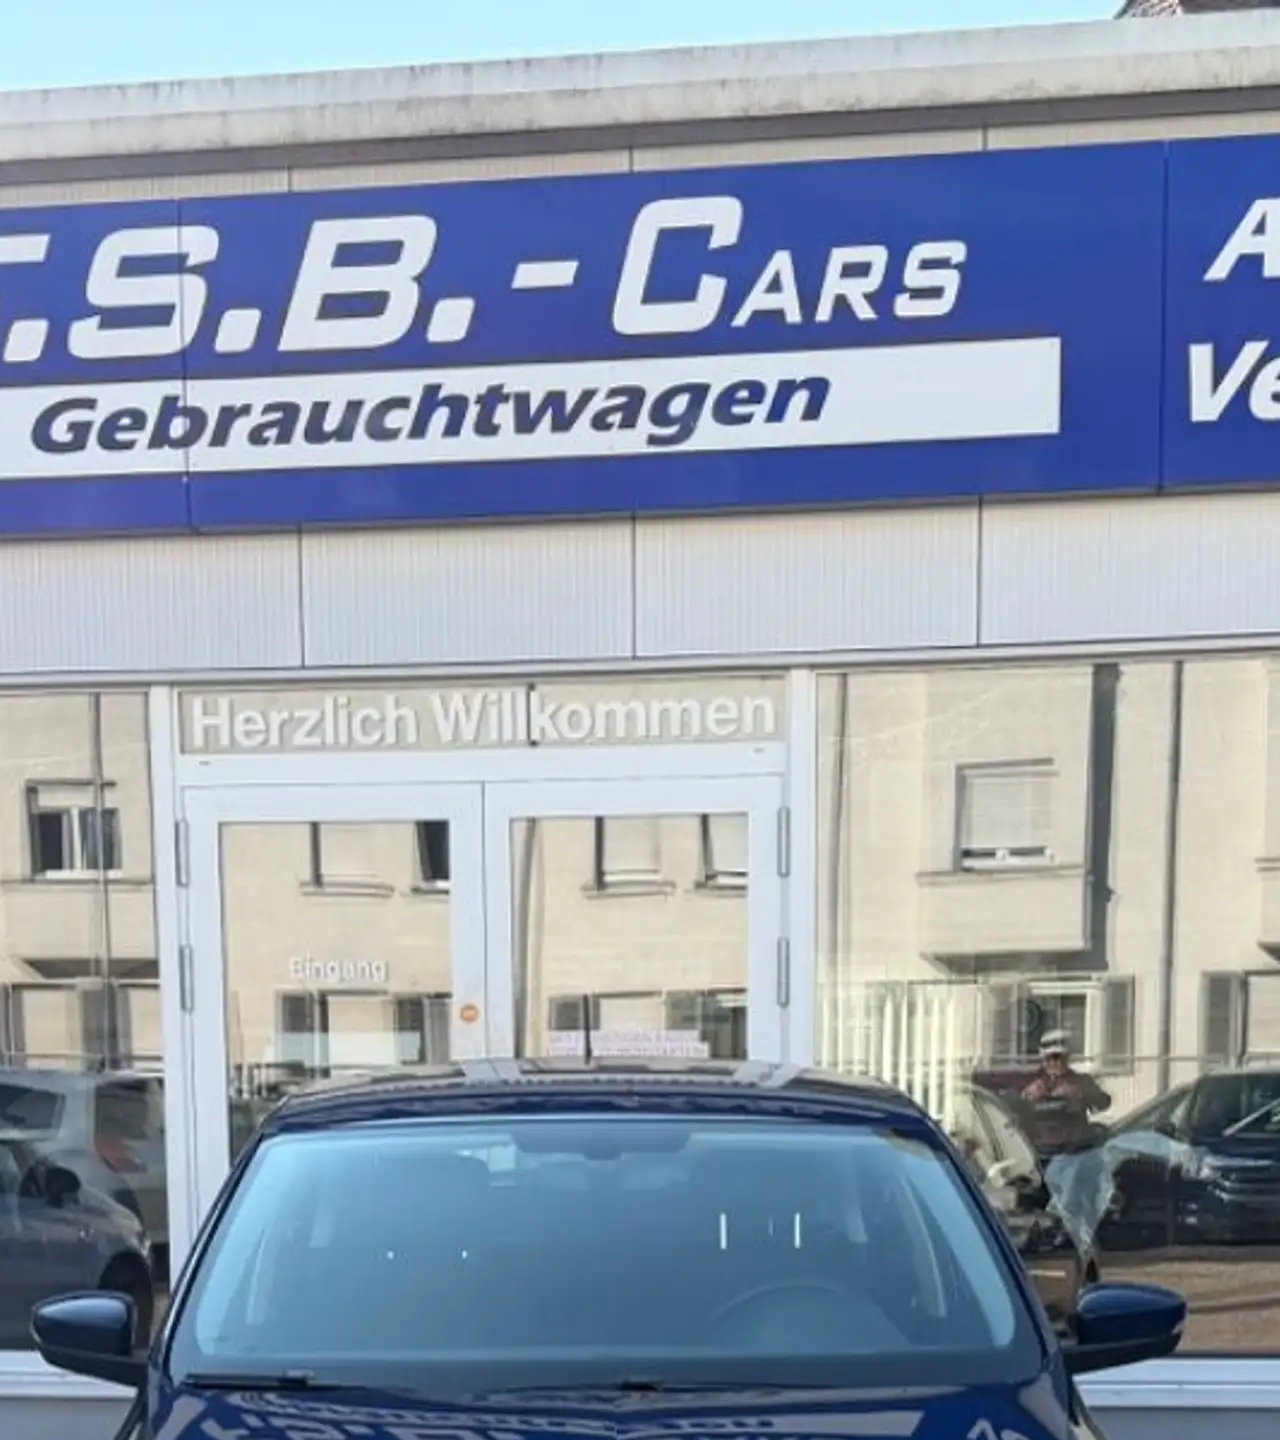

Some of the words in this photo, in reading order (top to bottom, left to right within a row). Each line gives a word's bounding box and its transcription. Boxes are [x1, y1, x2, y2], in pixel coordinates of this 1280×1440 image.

[30, 370, 831, 456] Gebrauchtwagen
[192, 693, 419, 748] Herzlich
[433, 687, 776, 743] Willkommen
[290, 954, 388, 982] Eingang
